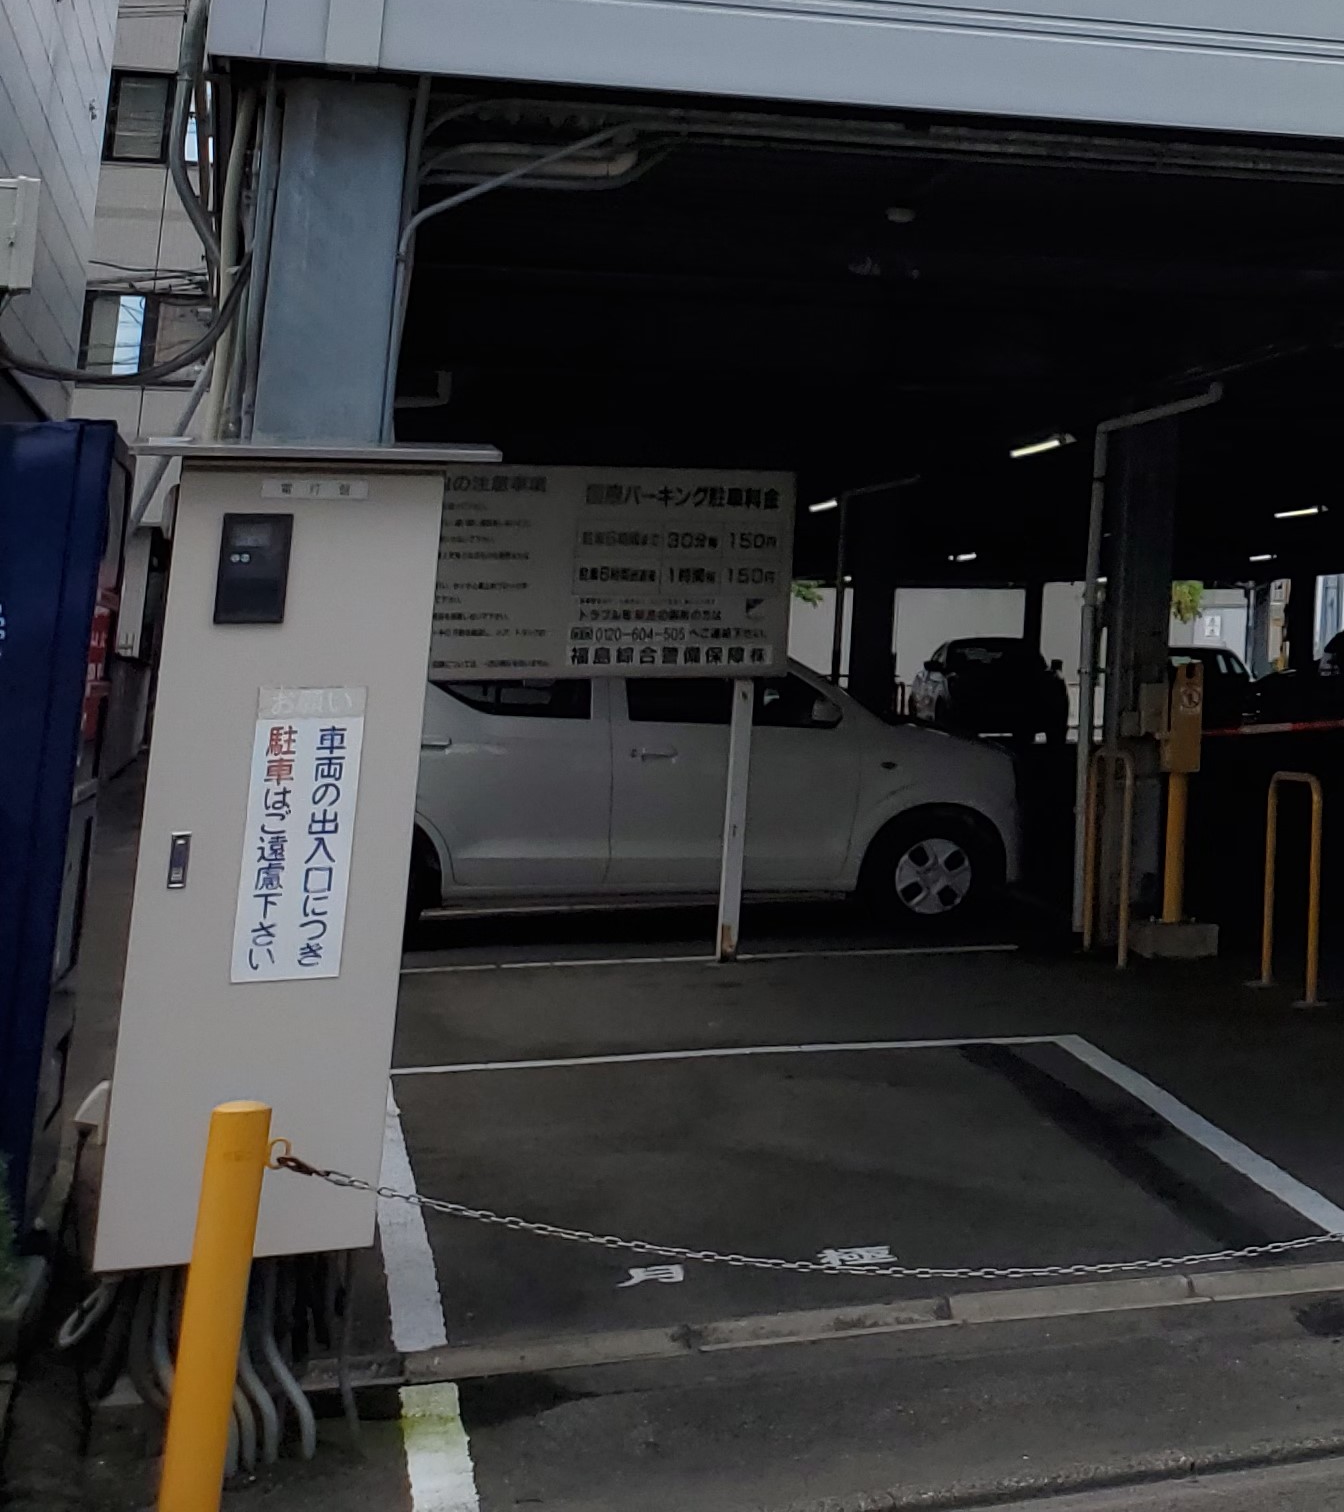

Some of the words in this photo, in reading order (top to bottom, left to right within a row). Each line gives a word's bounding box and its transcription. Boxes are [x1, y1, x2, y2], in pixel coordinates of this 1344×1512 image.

[249, 725, 298, 971] 駐車はご遠慮下さい
[298, 726, 347, 968] 車両の出入口につき
